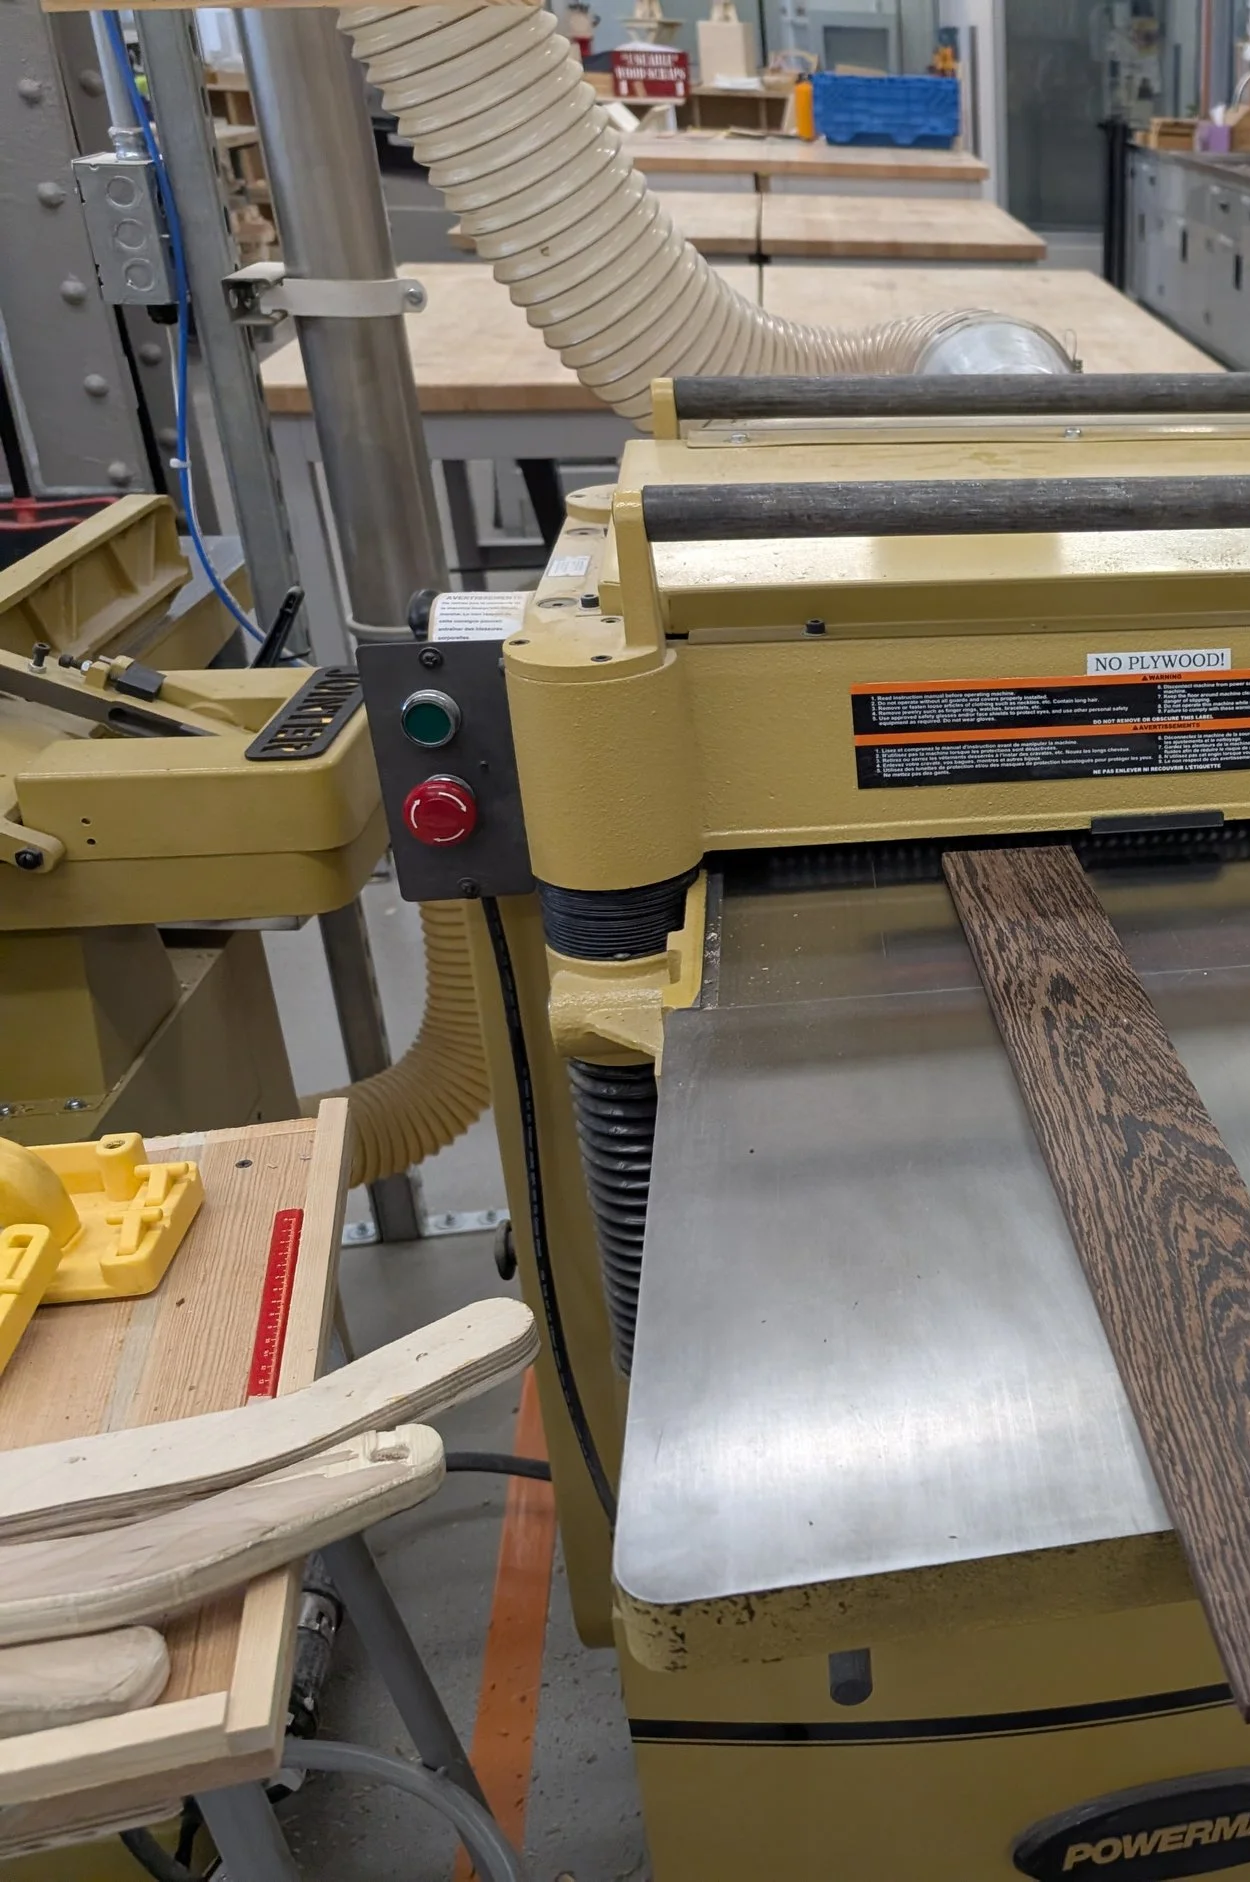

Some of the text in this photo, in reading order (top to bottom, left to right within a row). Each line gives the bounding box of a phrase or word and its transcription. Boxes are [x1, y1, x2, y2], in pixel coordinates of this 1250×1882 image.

[615, 66, 686, 81] WOOD SCRAPS
[1095, 652, 1225, 672] NO PLYWOOD!
[1149, 673, 1182, 681] WARNING
[1139, 722, 1201, 731] AVERTISSEMENTS
